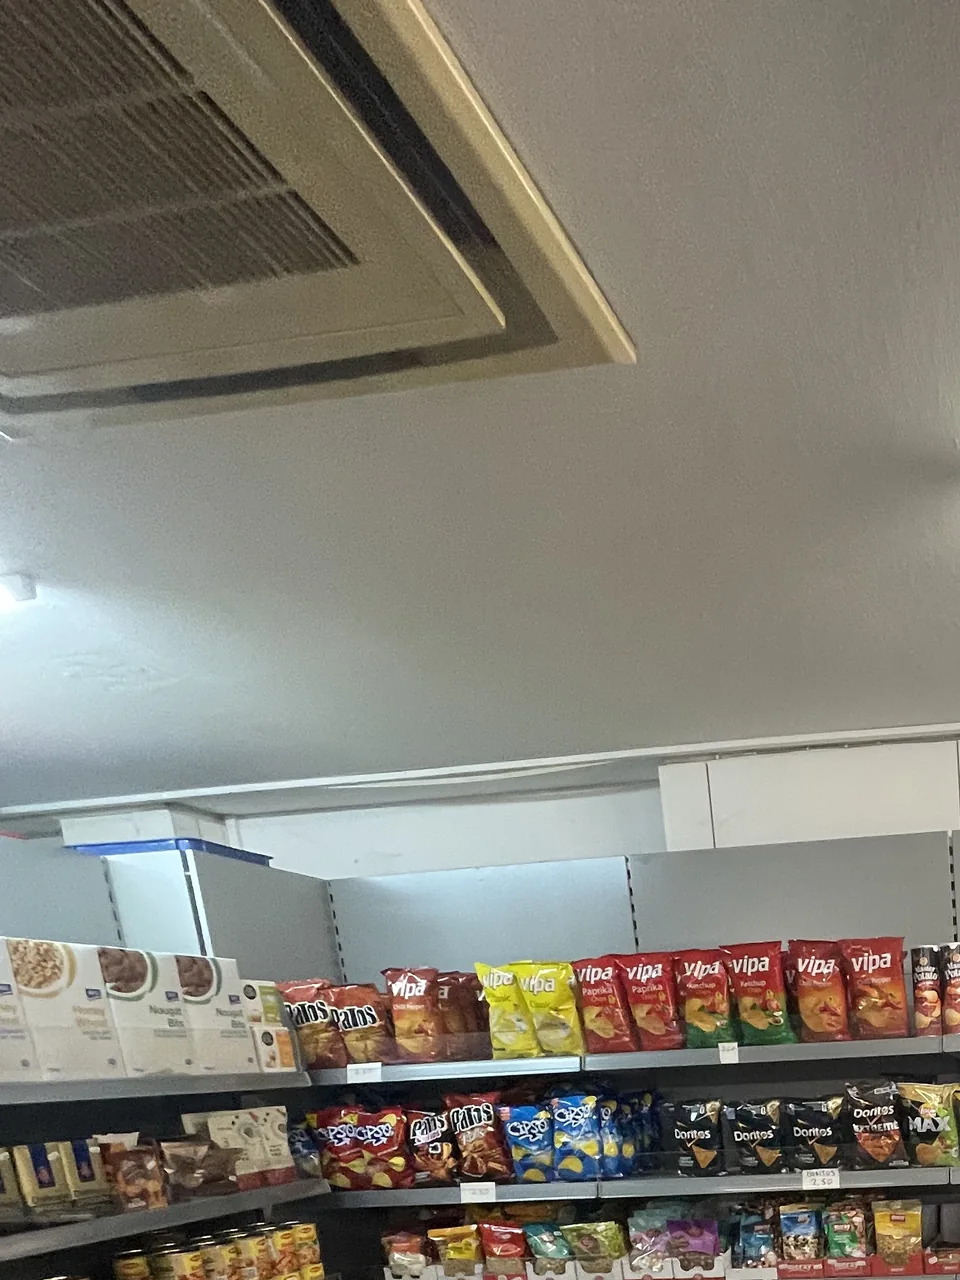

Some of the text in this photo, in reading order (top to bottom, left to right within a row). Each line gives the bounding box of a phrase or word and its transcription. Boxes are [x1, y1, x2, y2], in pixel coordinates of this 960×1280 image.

[684, 961, 720, 979] vipa
[731, 956, 769, 974] vipa
[797, 955, 835, 976] vipa
[851, 953, 891, 973] vipa
[577, 966, 613, 983] vipa
[627, 964, 663, 982] vipa
[391, 978, 426, 998] vipa
[582, 986, 613, 996] Paprika
[631, 984, 663, 994] Paprika
[149, 1005, 182, 1016] Nougat
[168, 1018, 185, 1028] Bits
[853, 1105, 895, 1118] Doritos
[908, 1116, 952, 1132] MAX
[674, 1128, 712, 1140] Doritos
[733, 1129, 775, 1142] Doritos
[793, 1126, 833, 1139] Doritos
